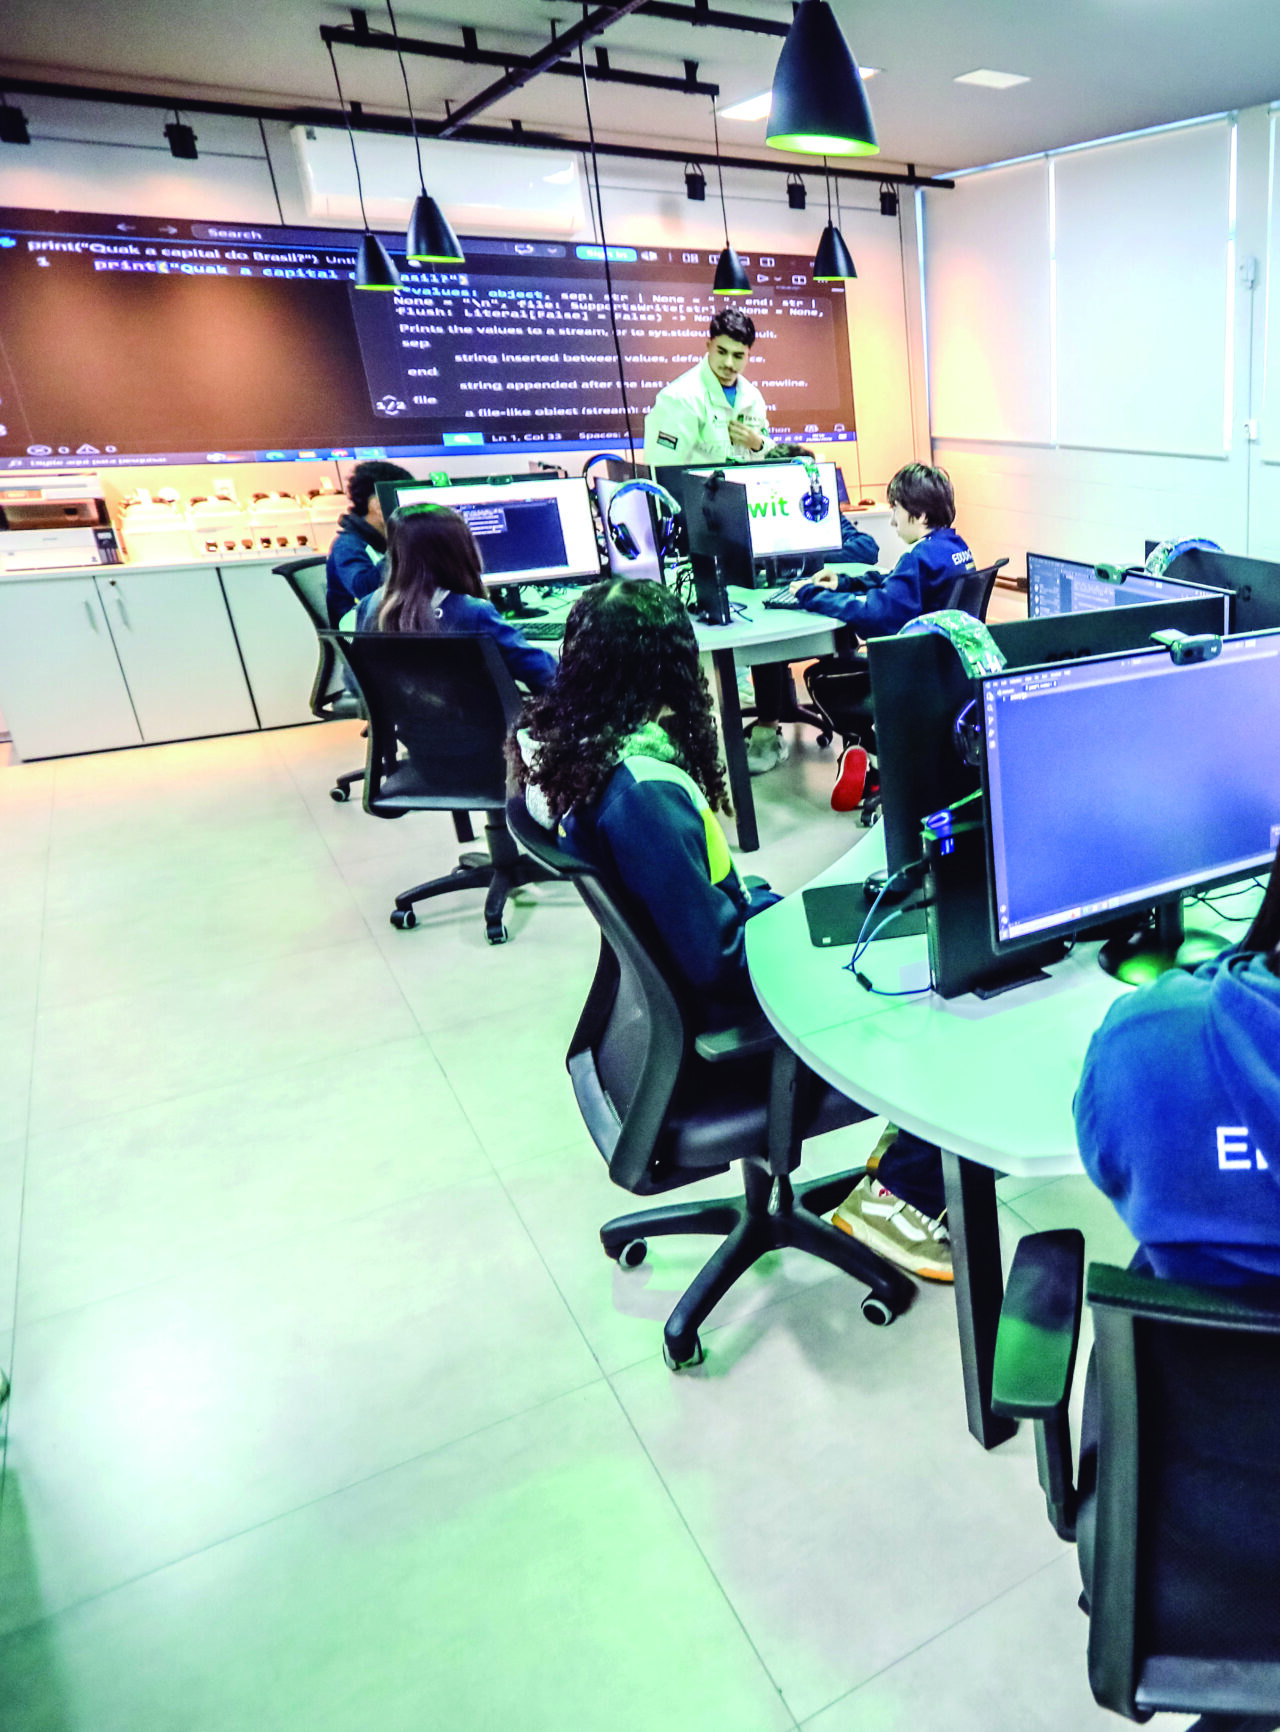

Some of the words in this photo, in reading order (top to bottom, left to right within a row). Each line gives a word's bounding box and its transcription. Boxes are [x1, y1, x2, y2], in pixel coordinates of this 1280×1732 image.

[208, 228, 263, 240] Search
[145, 247, 157, 256] a
[161, 247, 221, 260] capital
[225, 250, 249, 260] do
[240, 266, 253, 276] a
[262, 267, 338, 280] capital
[393, 296, 435, 307] None
[652, 294, 685, 304] None
[782, 299, 804, 307] str
[399, 323, 445, 335] Prints
[448, 324, 474, 335] the
[476, 325, 524, 336] values
[527, 326, 543, 336] to
[546, 328, 556, 336] a
[631, 328, 645, 337] to
[401, 339, 431, 350] sep
[454, 352, 499, 364] string
[501, 353, 560, 363] inserted
[407, 366, 440, 377] end
[459, 380, 504, 392] string
[506, 379, 578, 391] appended
[581, 379, 614, 390] after
[641, 379, 664, 389] last
[761, 380, 809, 389] newline.
[412, 395, 439, 405] file
[465, 409, 476, 418] a
[478, 407, 532, 417] file-like
[534, 407, 579, 417] object
[491, 434, 508, 443] Ln
[523, 433, 545, 442] Col
